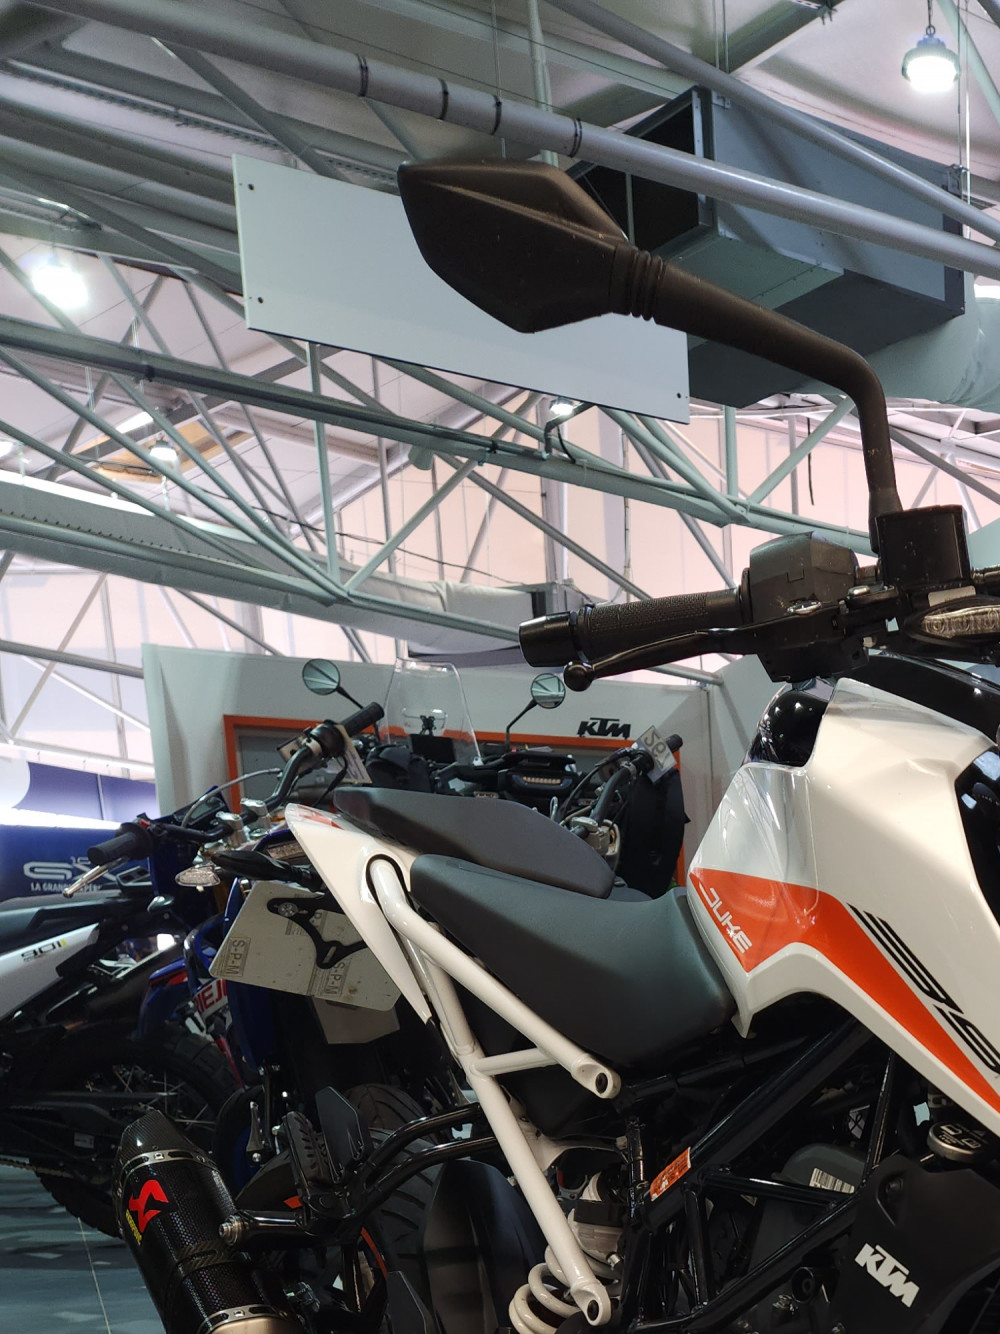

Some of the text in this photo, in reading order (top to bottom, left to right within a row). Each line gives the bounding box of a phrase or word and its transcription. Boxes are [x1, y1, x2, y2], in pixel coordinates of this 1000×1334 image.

[577, 717, 631, 738] KTM
[699, 881, 753, 954] DUKE
[225, 939, 246, 976] S-P-M
[854, 1242, 920, 1308] KTM
